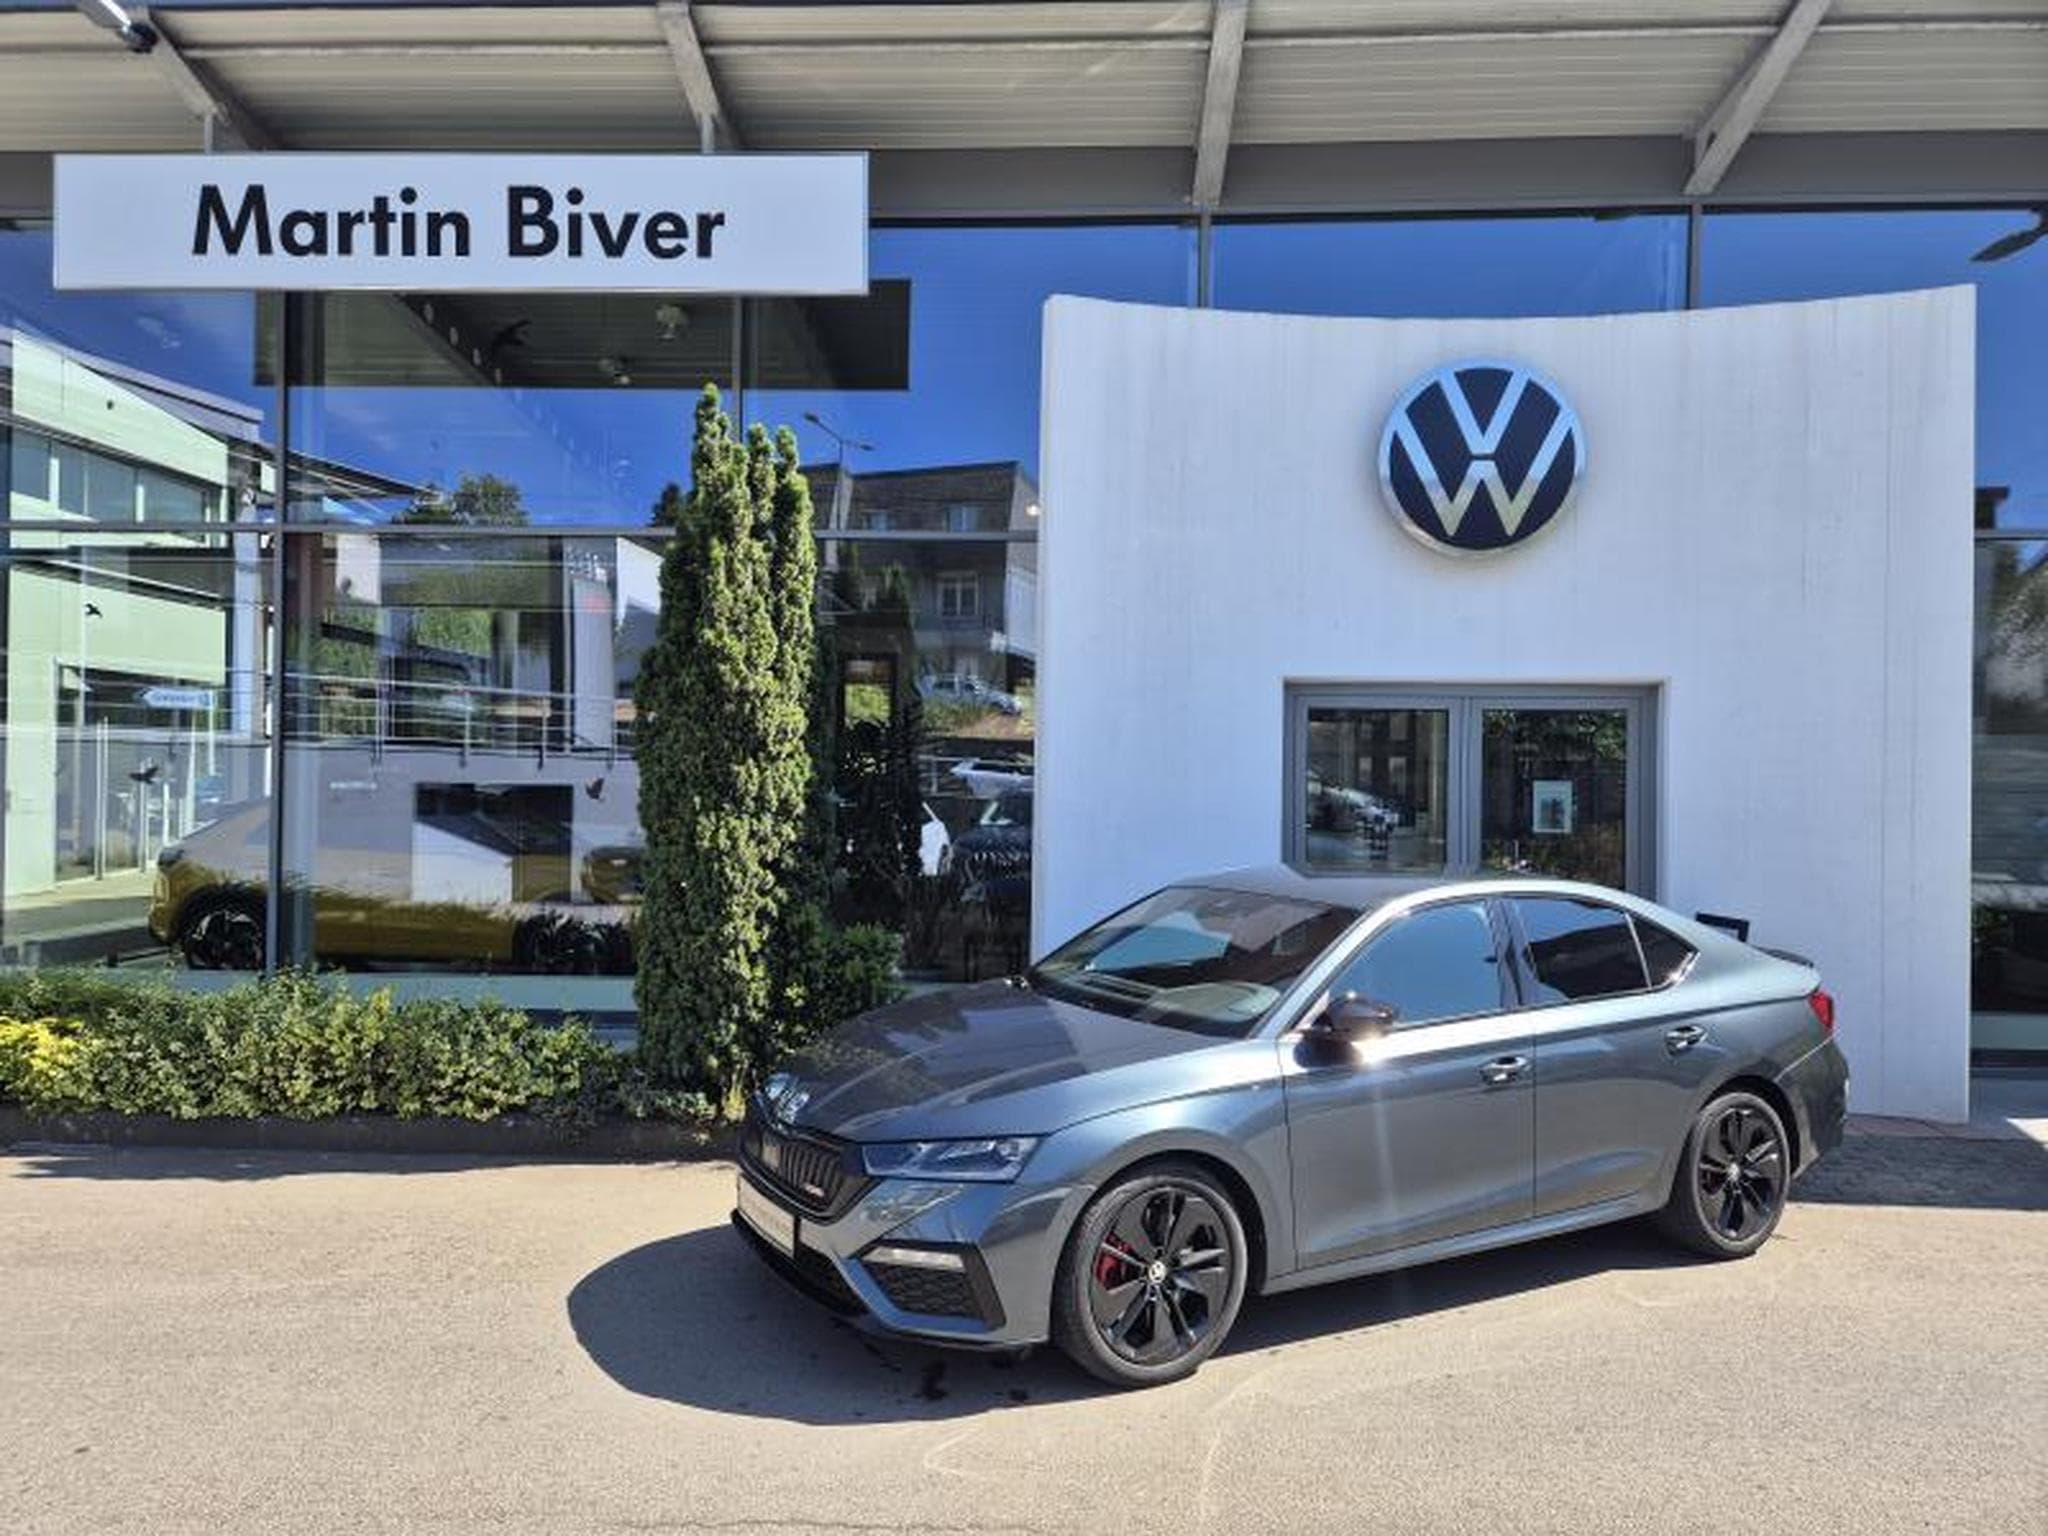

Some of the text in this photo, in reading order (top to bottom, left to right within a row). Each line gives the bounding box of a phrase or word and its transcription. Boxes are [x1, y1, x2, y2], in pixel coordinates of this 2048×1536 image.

[192, 184, 726, 260] Martin Biver
[1386, 363, 1579, 543] VW
